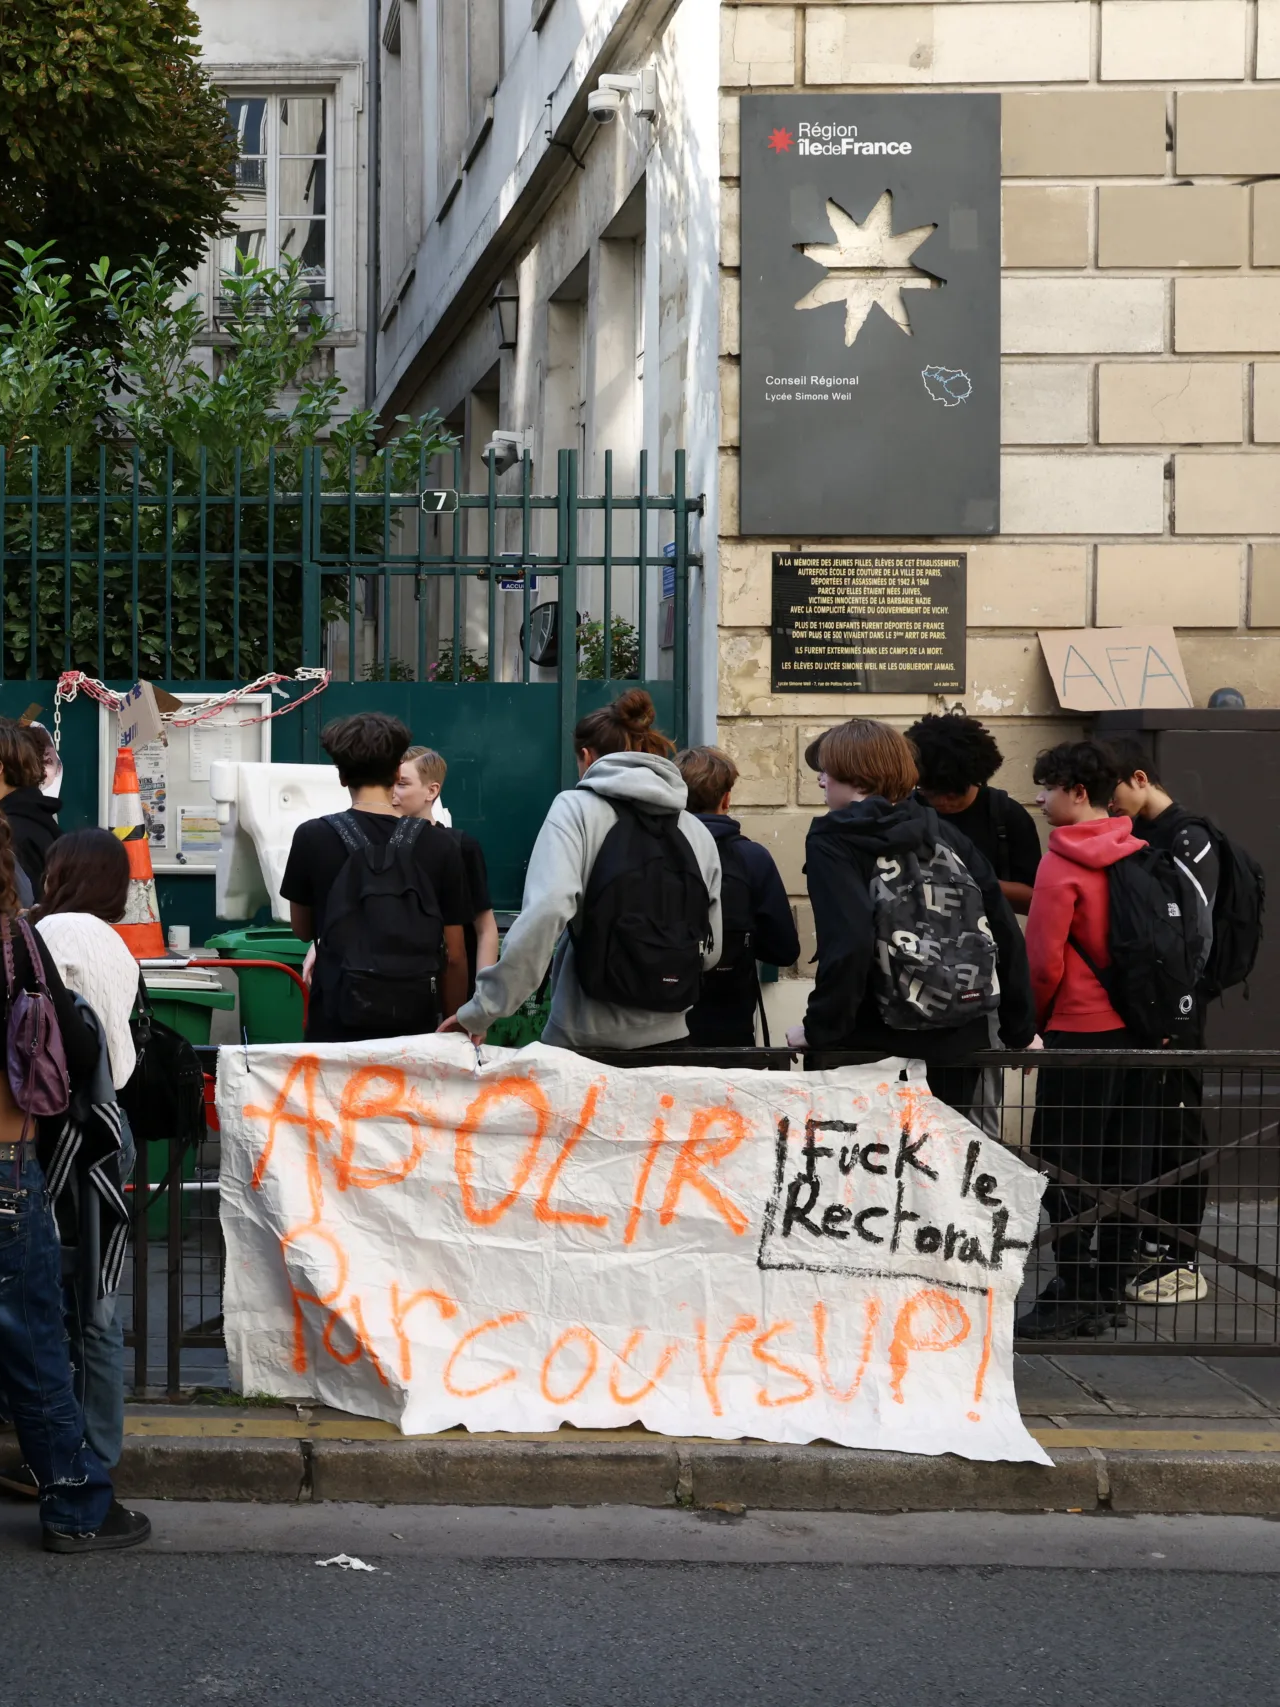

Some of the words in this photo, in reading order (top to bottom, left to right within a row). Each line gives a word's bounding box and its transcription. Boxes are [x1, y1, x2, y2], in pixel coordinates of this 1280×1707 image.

[798, 122, 858, 140] Région
[765, 375, 806, 386] Conseil
[810, 374, 859, 388] Régional
[765, 392, 792, 402] Lycée
[795, 392, 829, 400] Simone
[832, 392, 852, 400] Weil
[434, 492, 447, 510] 7
[779, 557, 783, 566] À
[794, 557, 819, 566] MÉMOIRE
[854, 559, 873, 567] FILLES,
[875, 558, 894, 566] ÉLÈVES
[916, 558, 960, 567] ÉTABLISSEMENT,
[829, 567, 846, 576] ÉCOLE
[811, 577, 842, 585] DÉPORTÉES
[852, 577, 887, 585] ASSASSINÉES
[911, 577, 915, 586] À
[864, 586, 885, 595] ÉTAIENT
[887, 586, 900, 595] NÉES
[902, 588, 922, 596] JUIVES,
[814, 605, 845, 614] COMPLICITÉ
[884, 620, 912, 629] DÉPORTÉS
[827, 645, 861, 654] EXTERMINÉS
[794, 661, 813, 670] ÉLÈVES
[824, 661, 840, 670] LYCÉE
[1063, 645, 1192, 707] AFA
[242, 1053, 753, 1244] ABOLIR
[802, 1117, 940, 1181] Fuck
[960, 1140, 1003, 1207] le
[782, 1172, 1030, 1270] Rectorat
